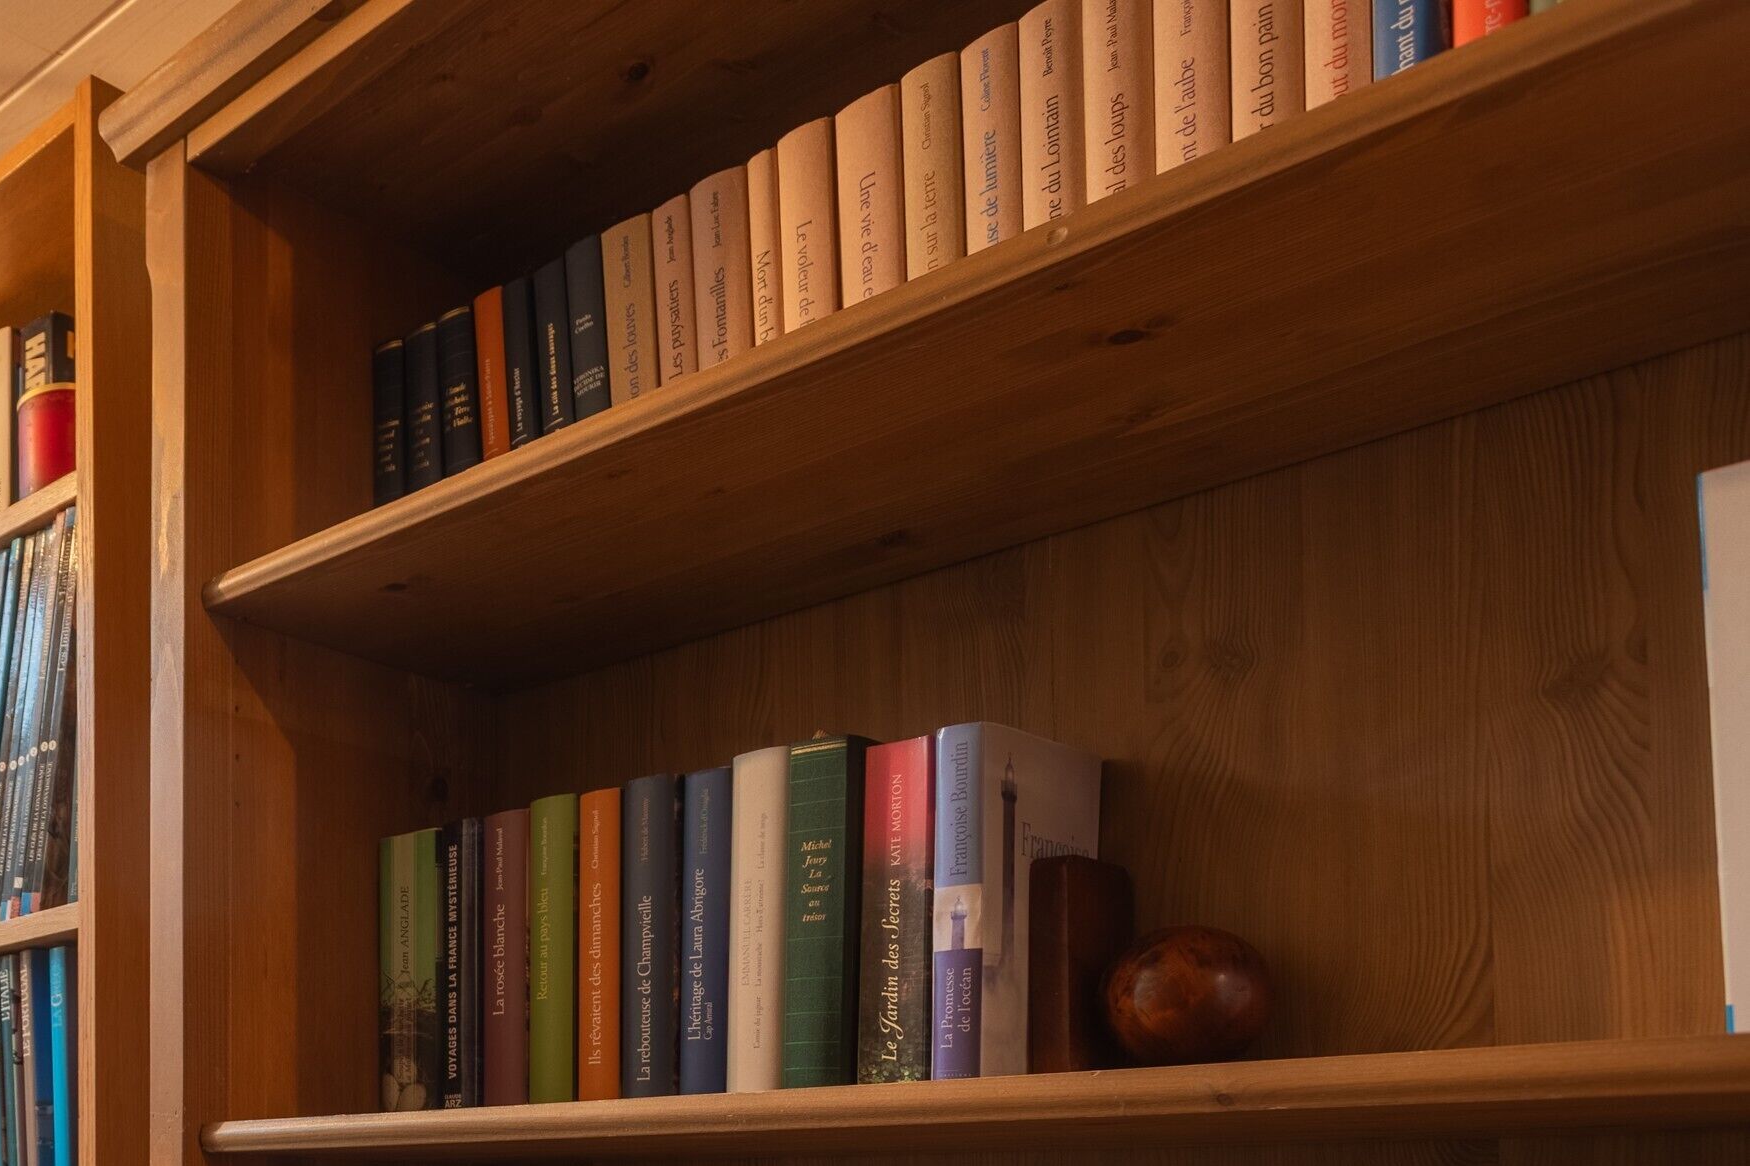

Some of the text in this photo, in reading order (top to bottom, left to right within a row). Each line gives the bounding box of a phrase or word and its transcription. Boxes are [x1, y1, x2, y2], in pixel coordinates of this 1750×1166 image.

[1324, 44, 1349, 69] du
[1390, 6, 1415, 30] du
[1174, 57, 1197, 137] de l'aube
[1250, 4, 1279, 117] du bon pain
[979, 128, 999, 217] de lumière
[1041, 94, 1062, 193] du Lointain
[1105, 93, 1129, 175] des loups
[858, 171, 878, 284] Une vie d'eau
[920, 170, 938, 255] sur la terre
[709, 267, 728, 349] Fontanilles
[755, 250, 771, 290] Mort
[795, 220, 815, 317] Le voleur de
[623, 303, 639, 373] des louves
[666, 279, 685, 380] Les puysatiers
[801, 838, 832, 851] Michel
[949, 740, 971, 876] Françoise Bourdin
[801, 881, 830, 894] Source
[809, 868, 822, 879] La
[399, 885, 410, 948] ANGLADE
[537, 887, 551, 1000] Retour au pays bleu
[687, 868, 706, 1041] L'héritage de Laura Abrigore
[879, 774, 904, 1061] Le Jardin des Secrets KATE MORTON
[0, 968, 11, 1022] L'ITALIE
[20, 964, 31, 1038] PORTUGAL
[447, 843, 458, 1079] VOYAGES DANS LA FRANCE MYSTÉRIEUSE
[493, 904, 505, 1016] La rosée blanche
[588, 883, 602, 1065] Ils rêvaient des dimanches
[636, 895, 654, 1081] La rebouteuse de Champvieille
[957, 967, 972, 1033] de l'océan
[941, 967, 954, 1049] La Promesse
